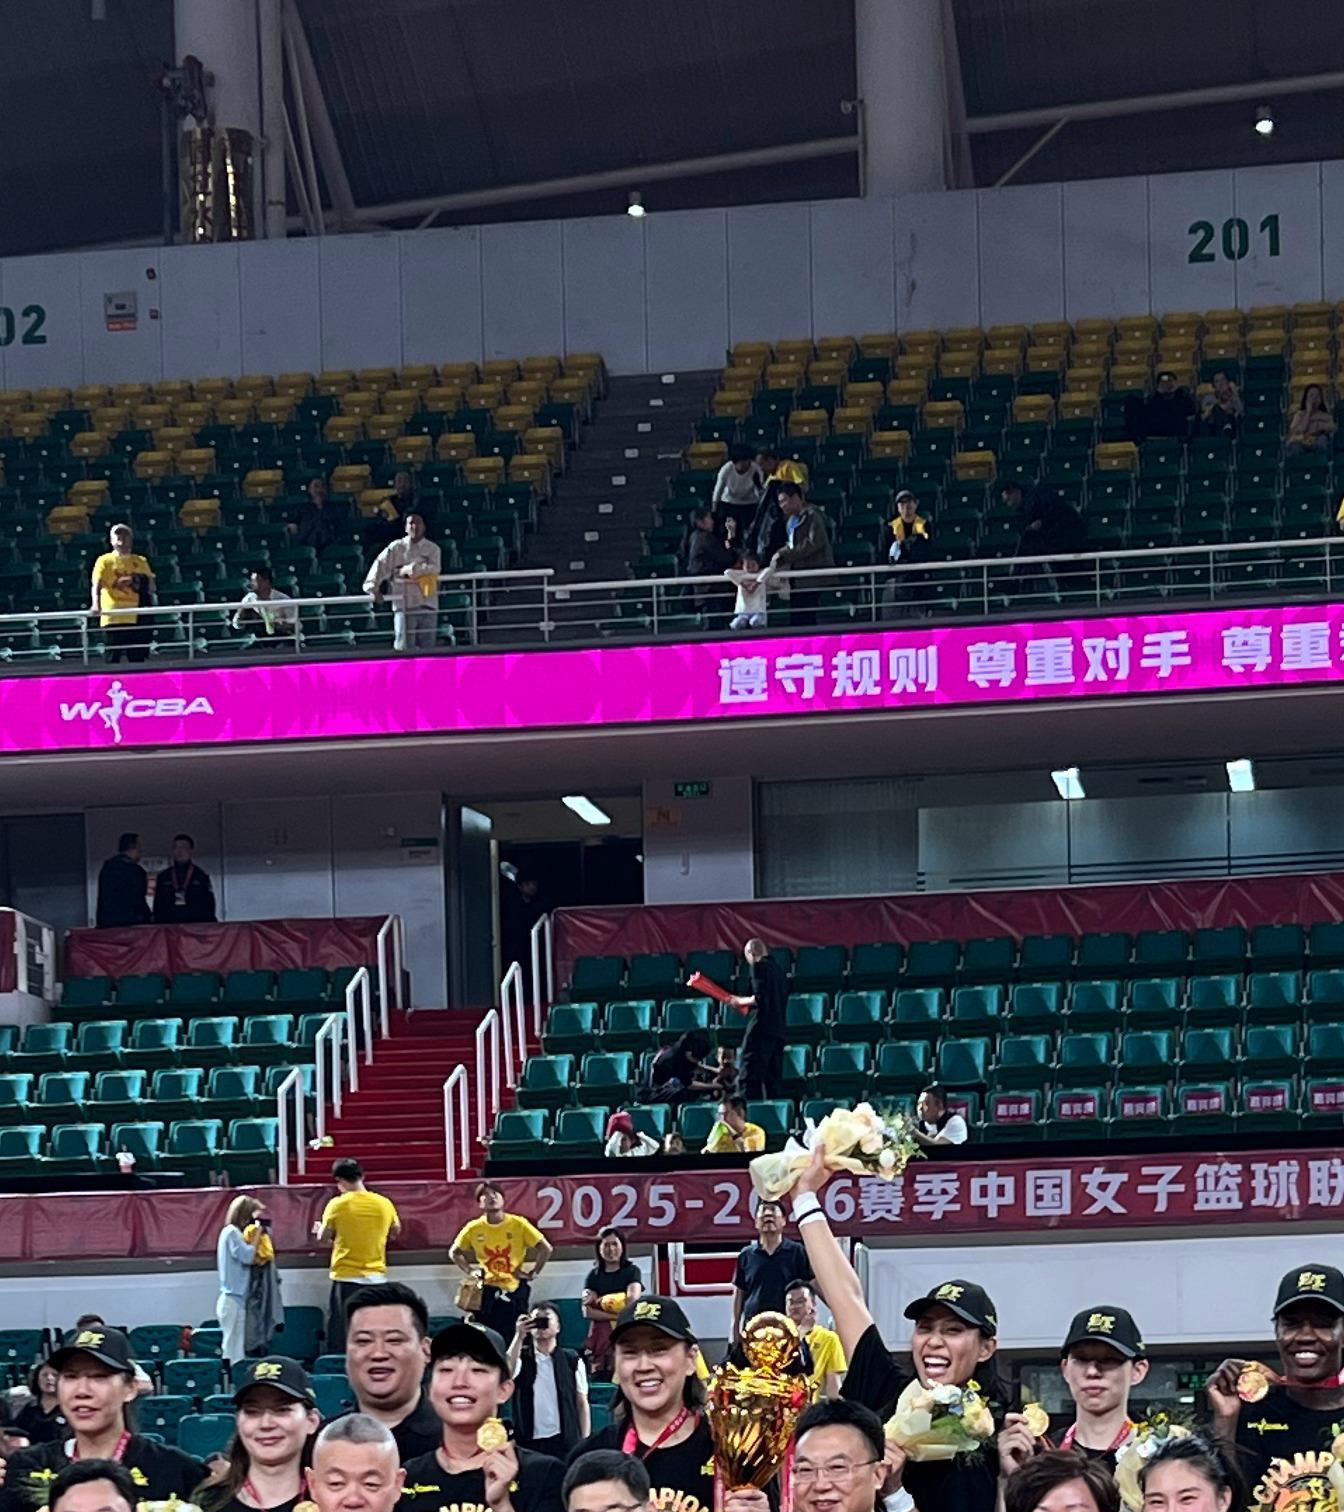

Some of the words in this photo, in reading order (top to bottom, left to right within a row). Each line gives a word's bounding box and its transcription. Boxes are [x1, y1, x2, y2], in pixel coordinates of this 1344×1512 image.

[1188, 214, 1280, 264] 201
[718, 646, 939, 704] 遵守规则
[967, 629, 1193, 687] 尊重对手
